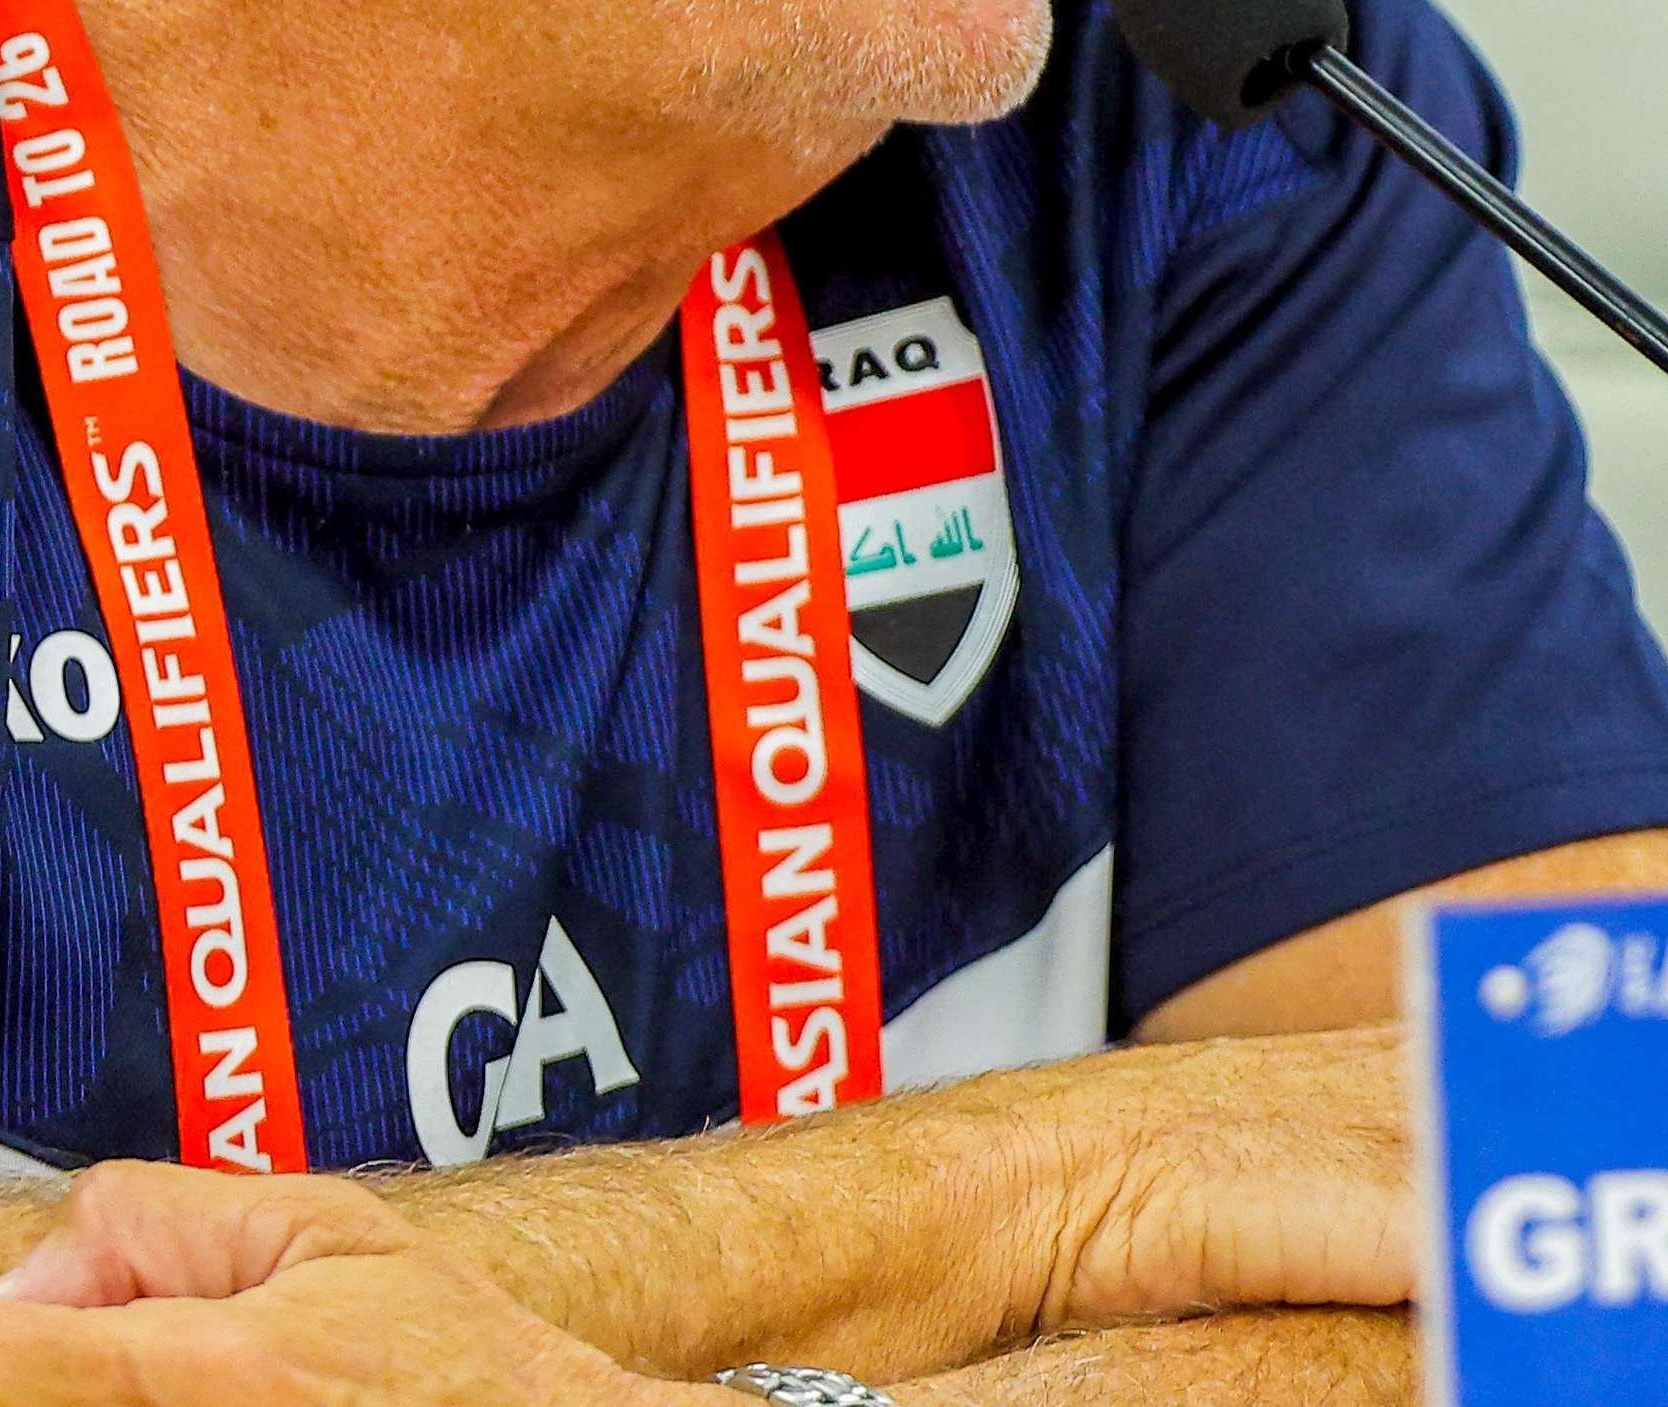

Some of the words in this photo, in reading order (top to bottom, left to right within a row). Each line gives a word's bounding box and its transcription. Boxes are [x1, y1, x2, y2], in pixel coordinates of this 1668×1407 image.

[13, 129, 96, 208] TO
[38, 216, 139, 384] ROAD
[710, 248, 829, 806] QUALIFIERS
[405, 913, 640, 1168] GA
[757, 822, 849, 1118] ASIAN
